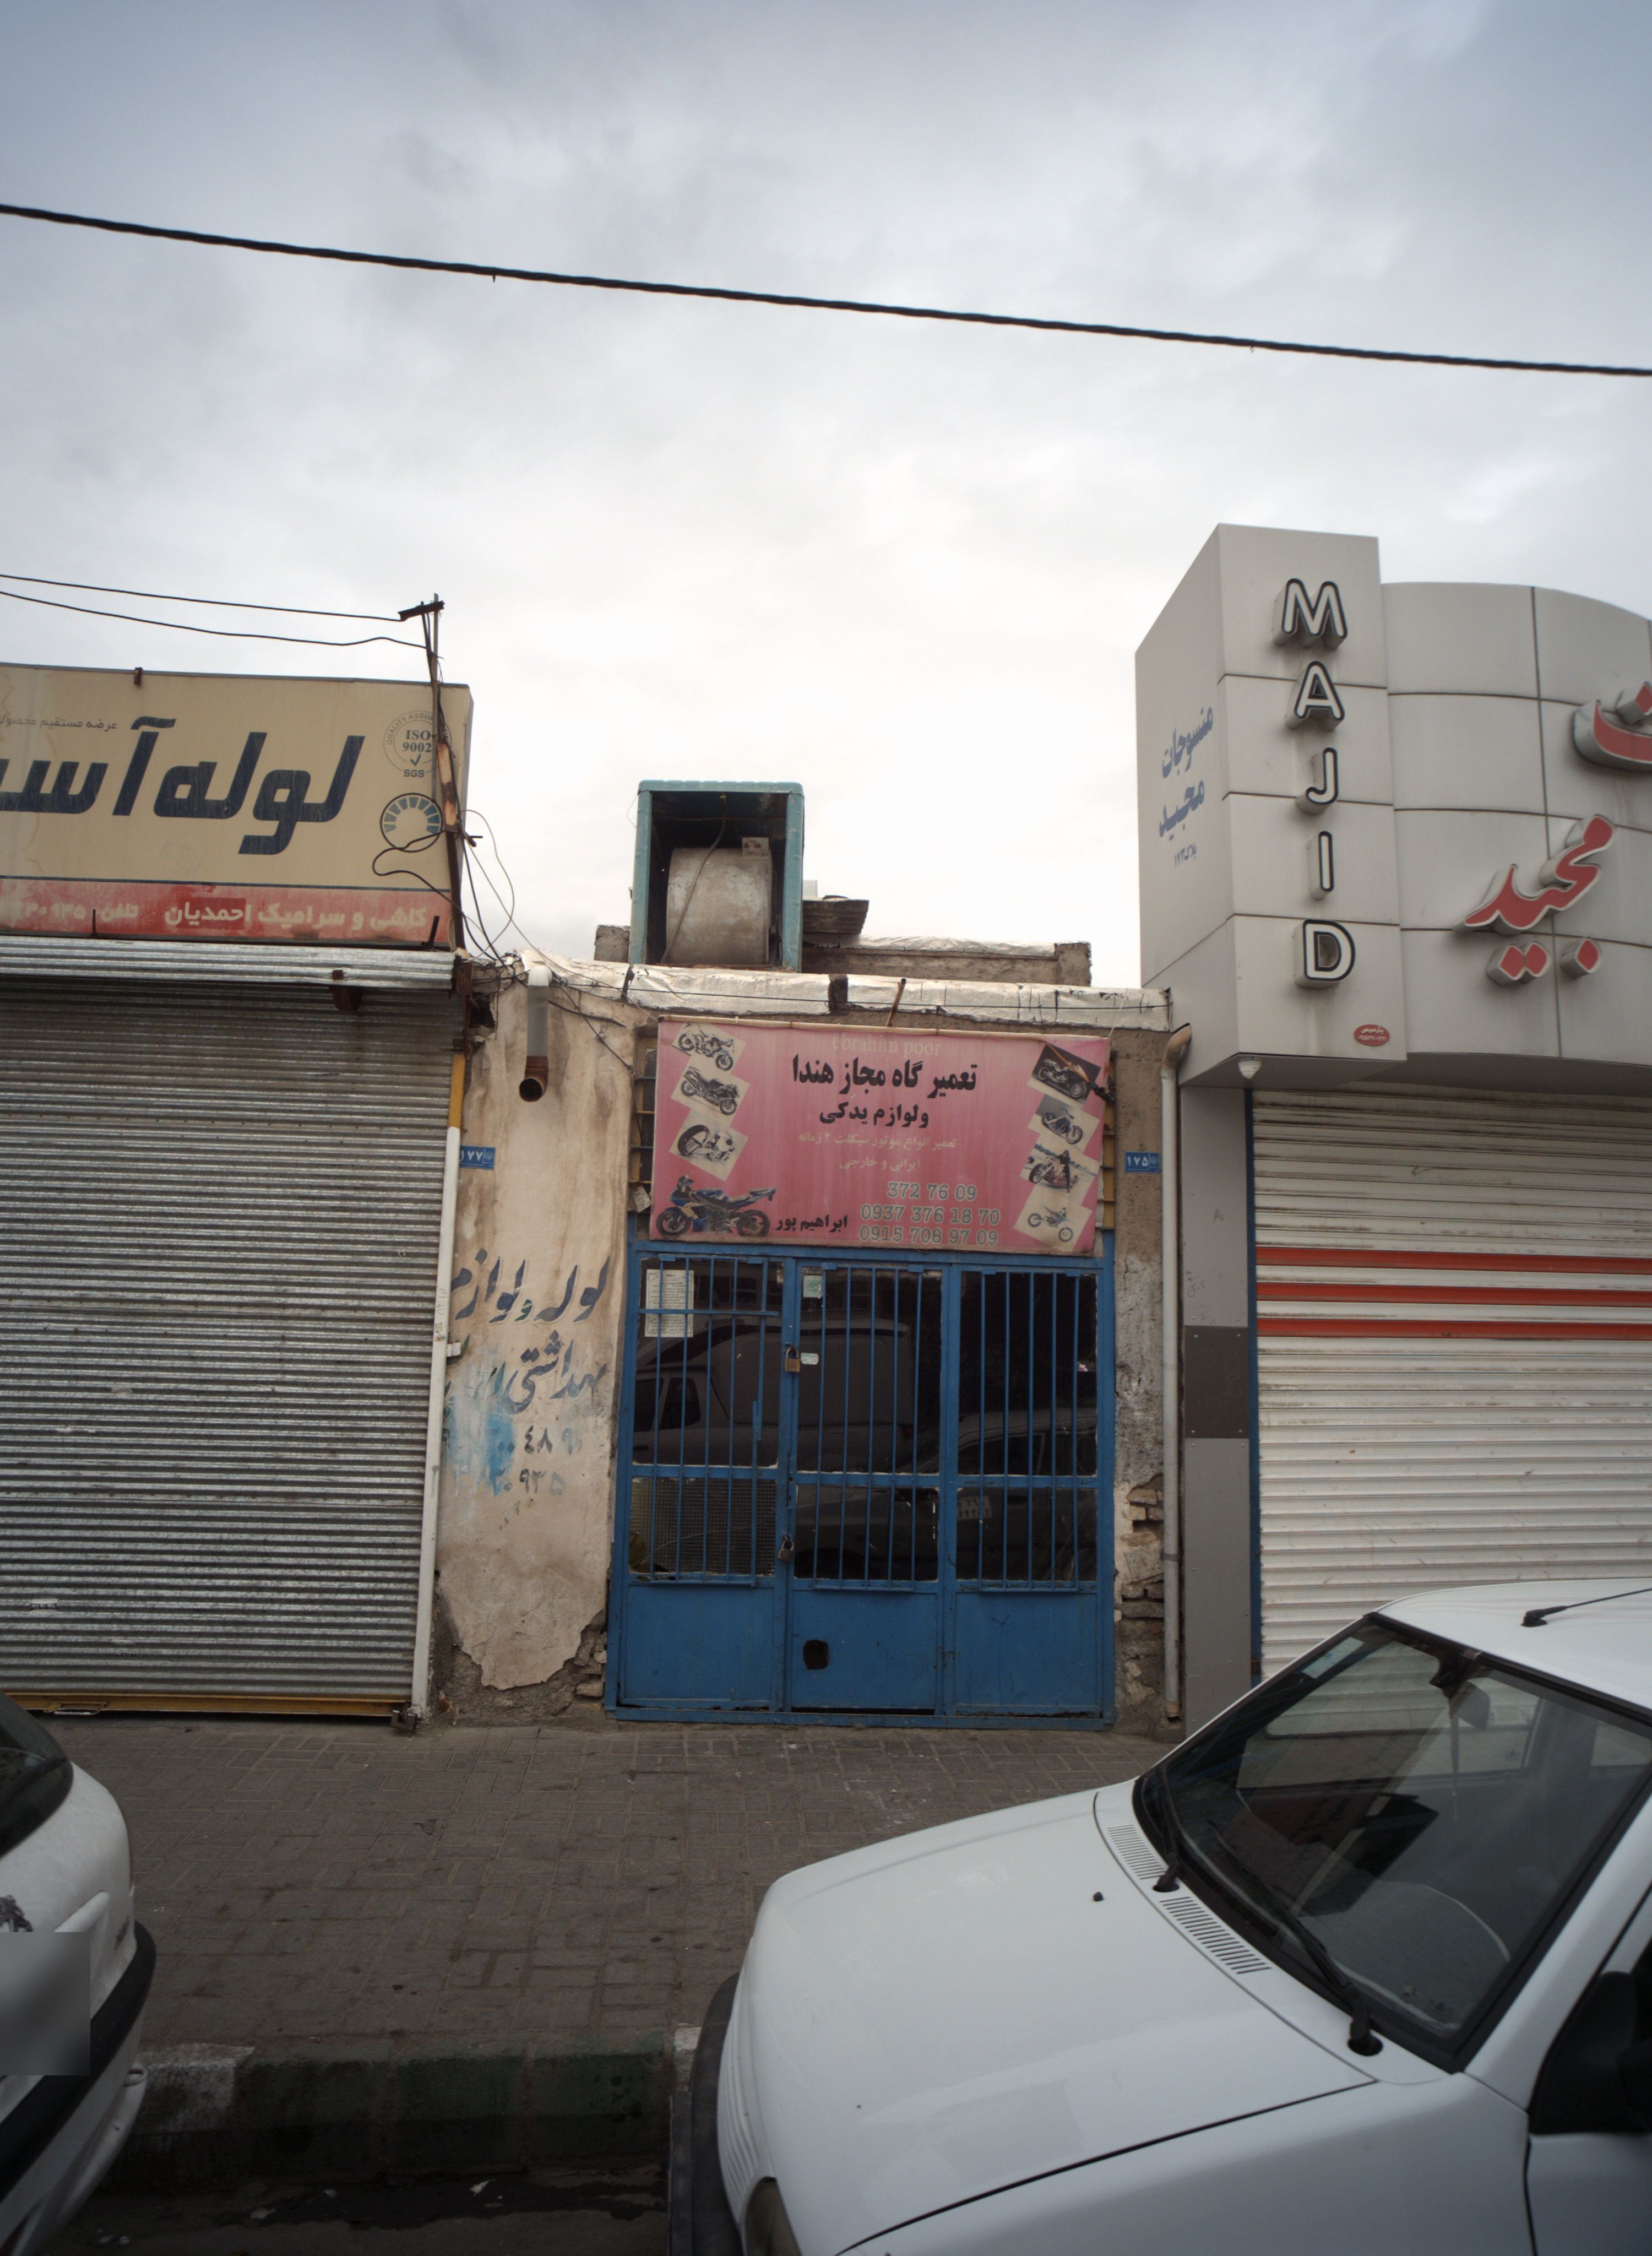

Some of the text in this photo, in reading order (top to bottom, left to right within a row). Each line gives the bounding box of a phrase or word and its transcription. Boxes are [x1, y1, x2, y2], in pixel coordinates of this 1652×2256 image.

[40, 717, 83, 730] مستقیم
[86, 719, 118, 732] عرضه
[386, 717, 406, 745] QUALITY
[405, 729, 431, 740] ISO
[1161, 706, 1214, 779] منسوجات
[403, 741, 432, 752] 9002
[1274, 577, 1356, 984] MAJID
[154, 731, 366, 855] لوله
[1159, 780, 1205, 841] مجید
[1464, 814, 1613, 981] مجید
[165, 902, 252, 926] احمدیان
[257, 902, 345, 930] سرامیک
[352, 910, 364, 930] و
[369, 907, 427, 931] کاشی
[903, 1041, 942, 1059] poor
[792, 1053, 978, 1099] تعمیر گاه مجاز هندا
[819, 1102, 868, 1125] یدکی
[798, 1132, 822, 1144] زمانه
[834, 1134, 869, 1147] سیکلت
[871, 1136, 901, 1149] موتور
[903, 1136, 930, 1150] انواع
[932, 1138, 958, 1151] تعمیر
[839, 1156, 921, 1172] ایرانی و خارجی
[1127, 1156, 1149, 1167] ۱۷۵
[888, 1181, 978, 1201] 372 76 09
[775, 1214, 848, 1234] ابراهیم پور
[860, 1203, 1001, 1225] 0937 376 18 70
[858, 1224, 999, 1246] 0915 708 97 09
